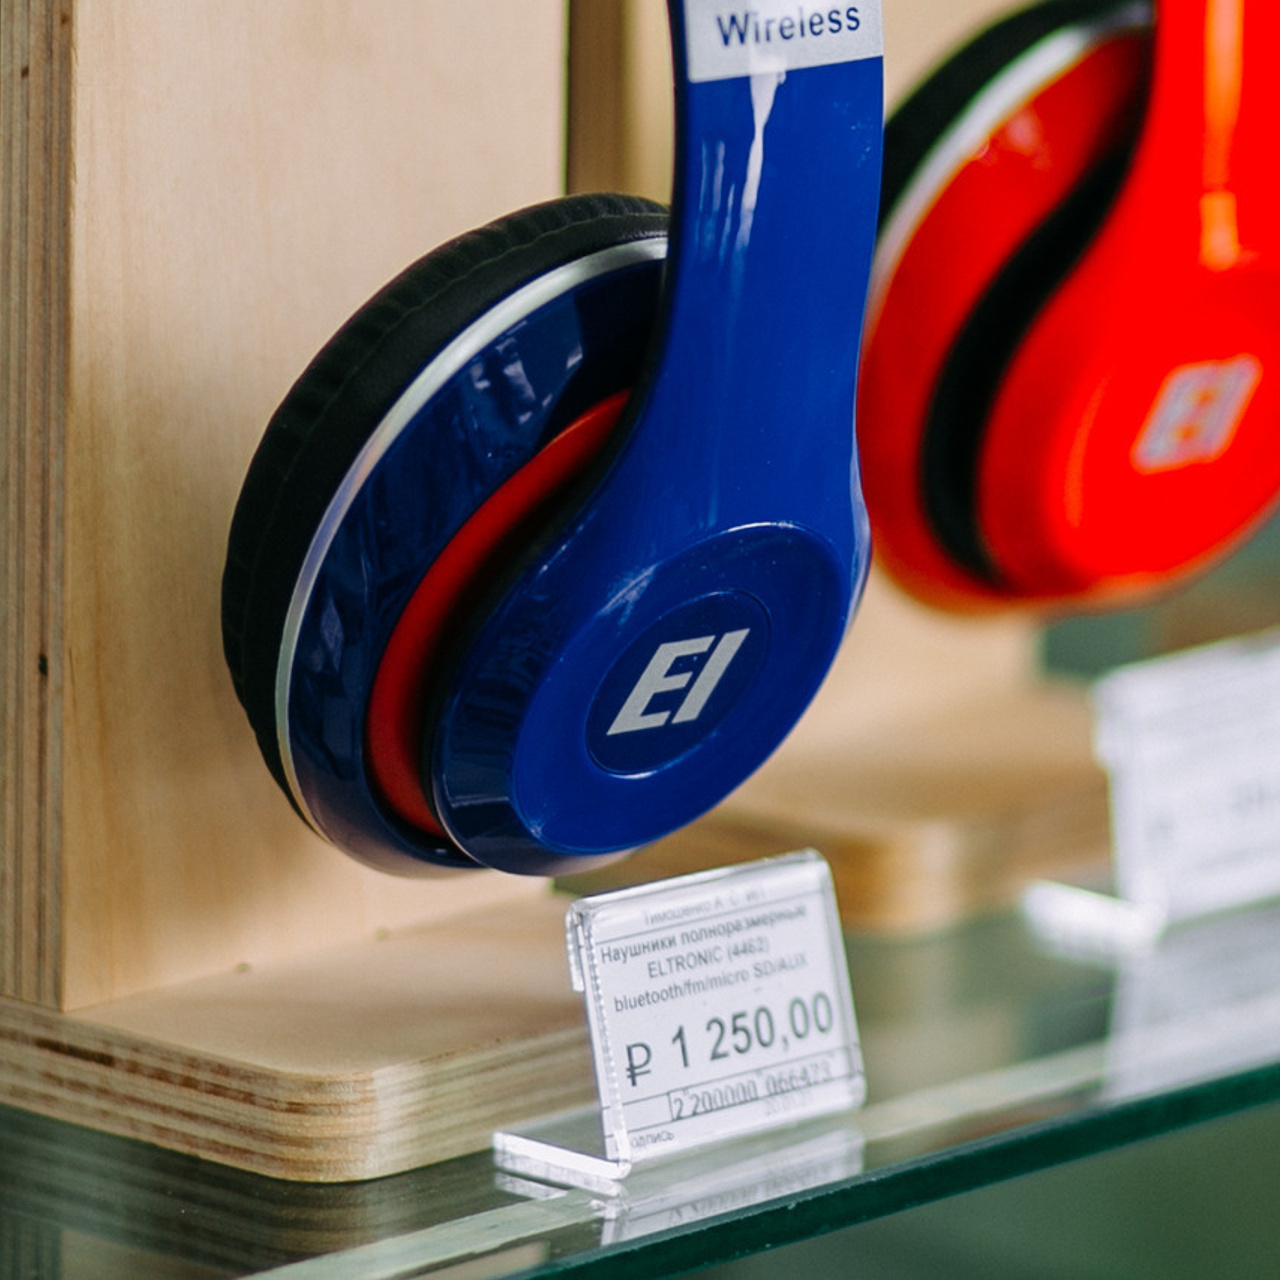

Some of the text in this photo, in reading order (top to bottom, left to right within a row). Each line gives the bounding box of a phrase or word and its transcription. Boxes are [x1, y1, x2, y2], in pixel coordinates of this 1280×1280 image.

[716, 6, 861, 47] Wireless
[600, 933, 677, 964] Наушники
[647, 946, 723, 979] ELTRONIC
[614, 969, 750, 1012] bluetooth/fm/micro
[671, 1024, 690, 1068] 1
[705, 990, 834, 1061] 250,00
